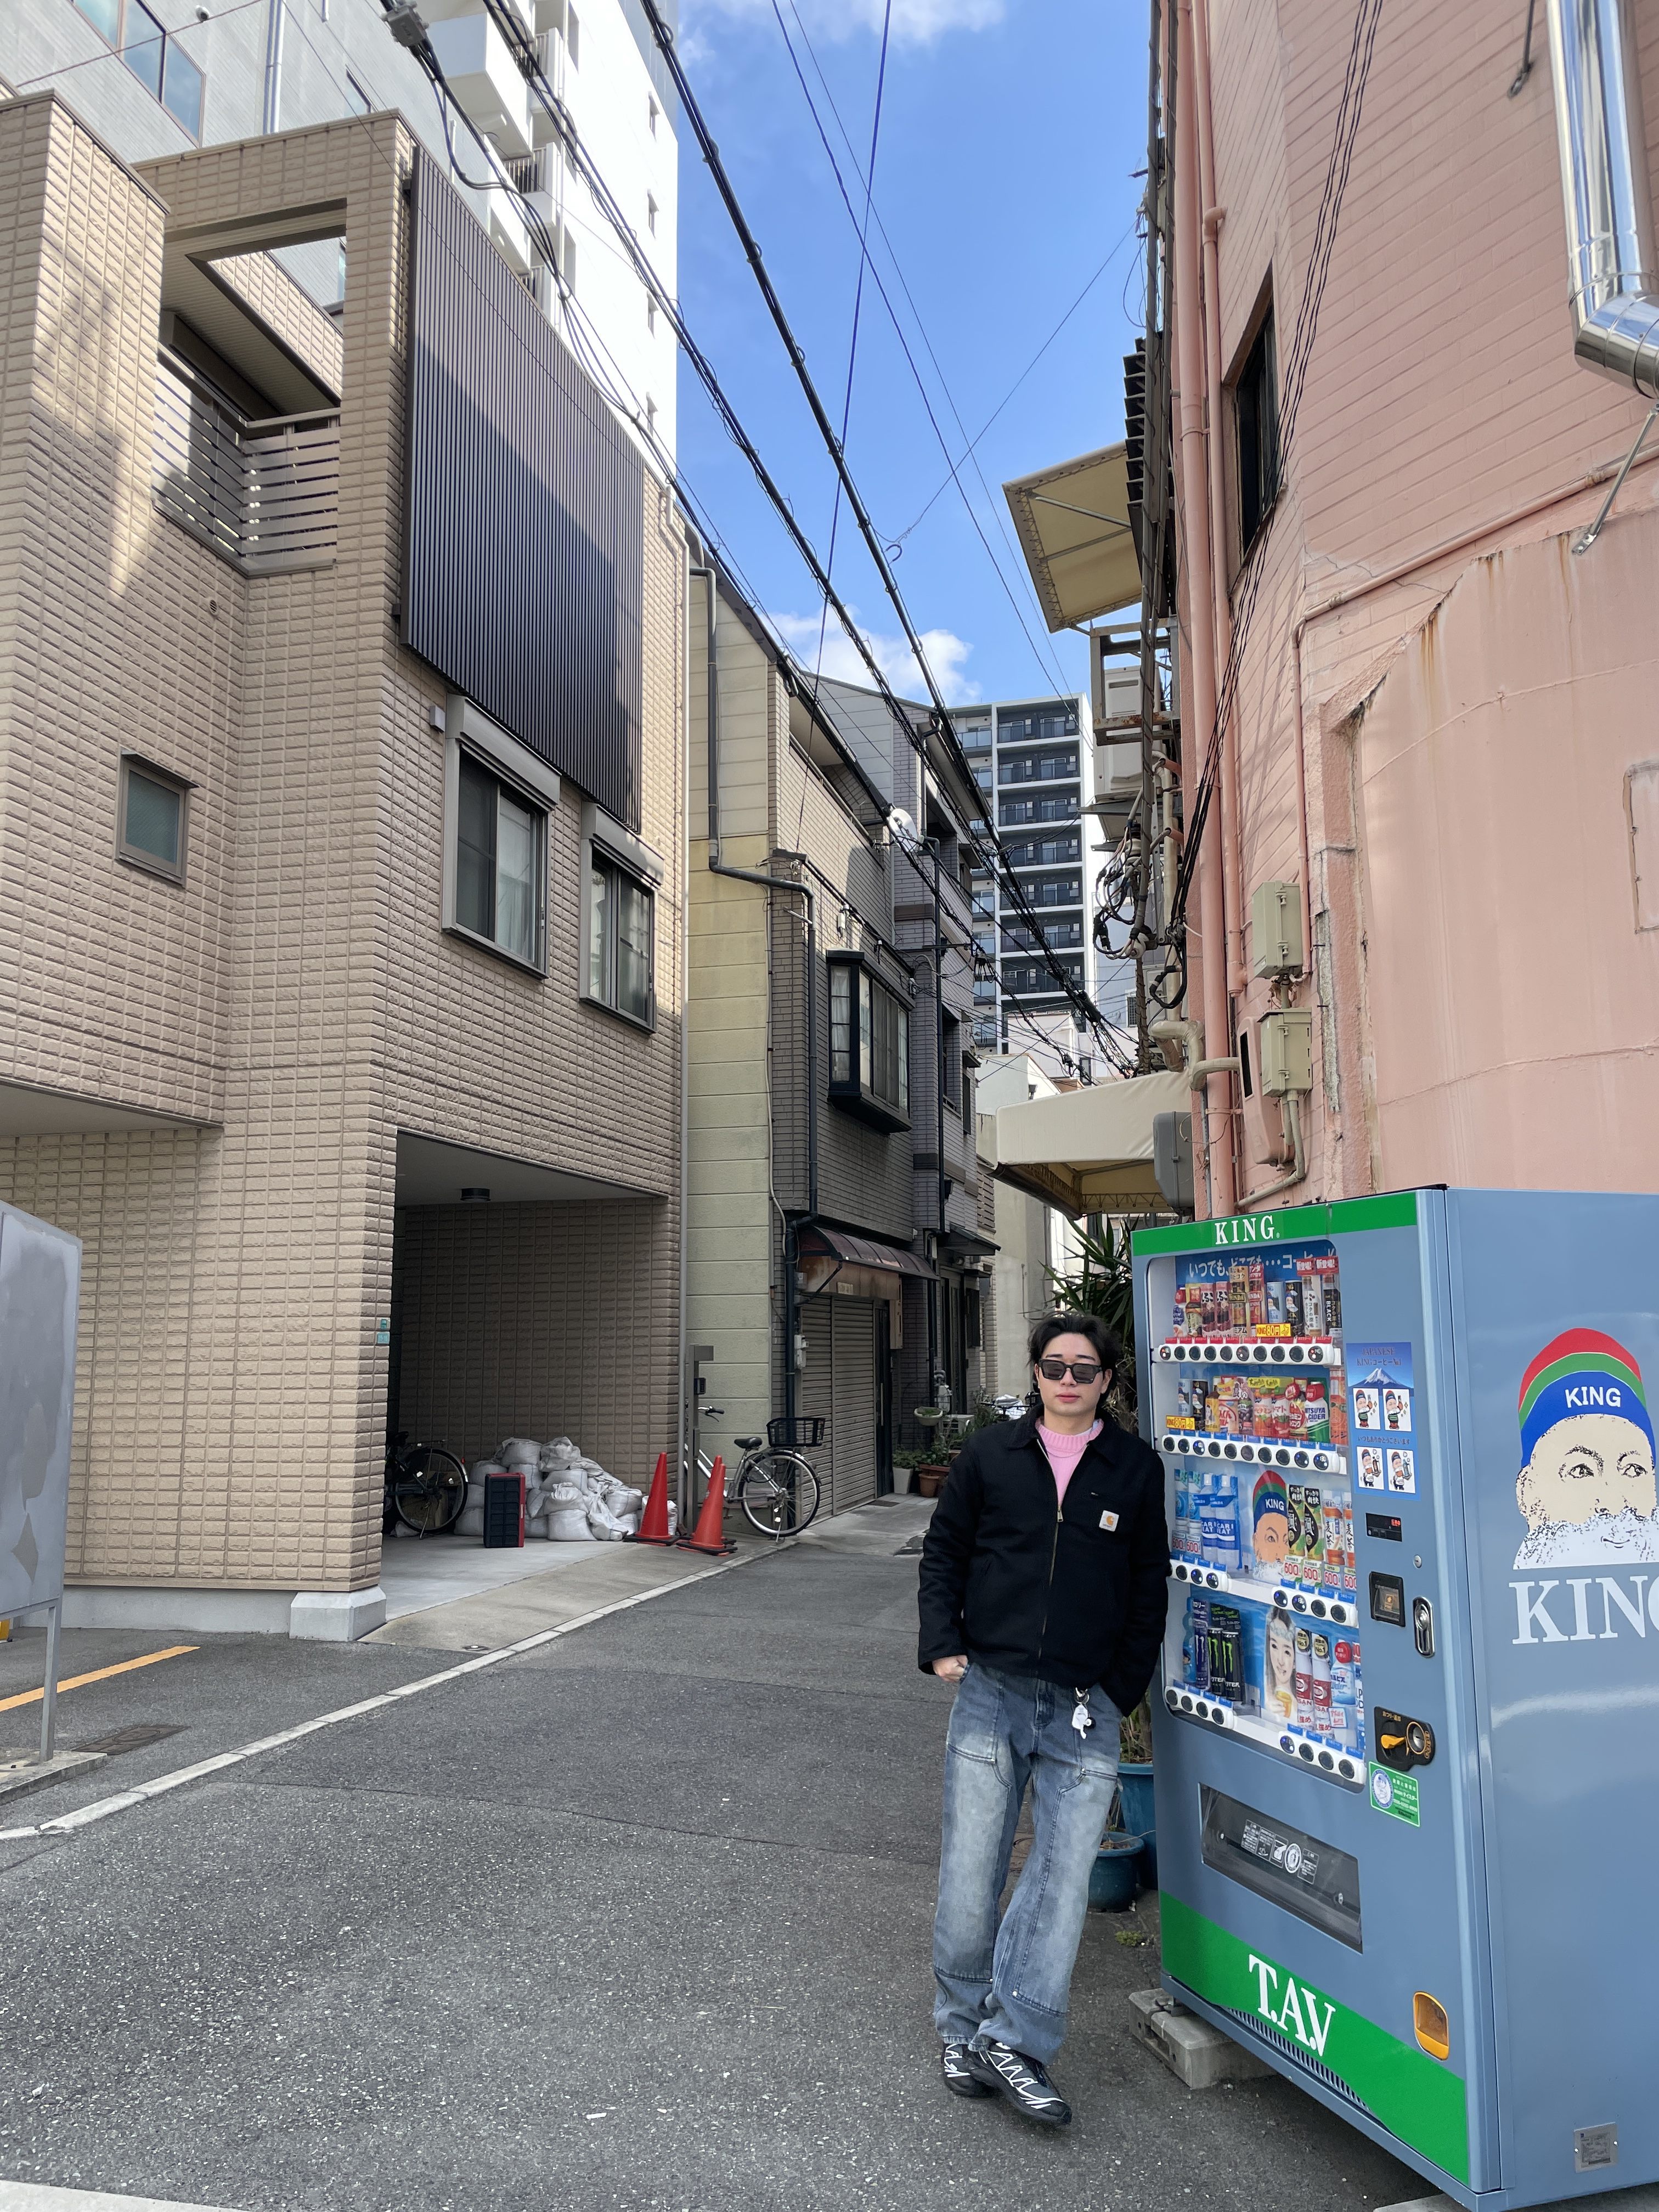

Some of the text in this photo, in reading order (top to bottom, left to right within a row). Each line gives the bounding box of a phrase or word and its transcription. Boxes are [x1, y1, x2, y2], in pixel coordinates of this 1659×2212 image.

[1215, 1215, 1274, 1245] KING
[1361, 1347, 1395, 1356] JAPANESE
[1565, 1386, 1621, 1408] KING
[1265, 1498, 1284, 1511] KING
[1325, 1521, 1334, 1549] 麦茶
[1346, 1522, 1354, 1551] 麦茶
[1284, 1562, 1299, 1576] 600
[1304, 1567, 1318, 1581] 600
[1325, 1572, 1338, 1585] 600
[1509, 1575, 1659, 1644] KIN
